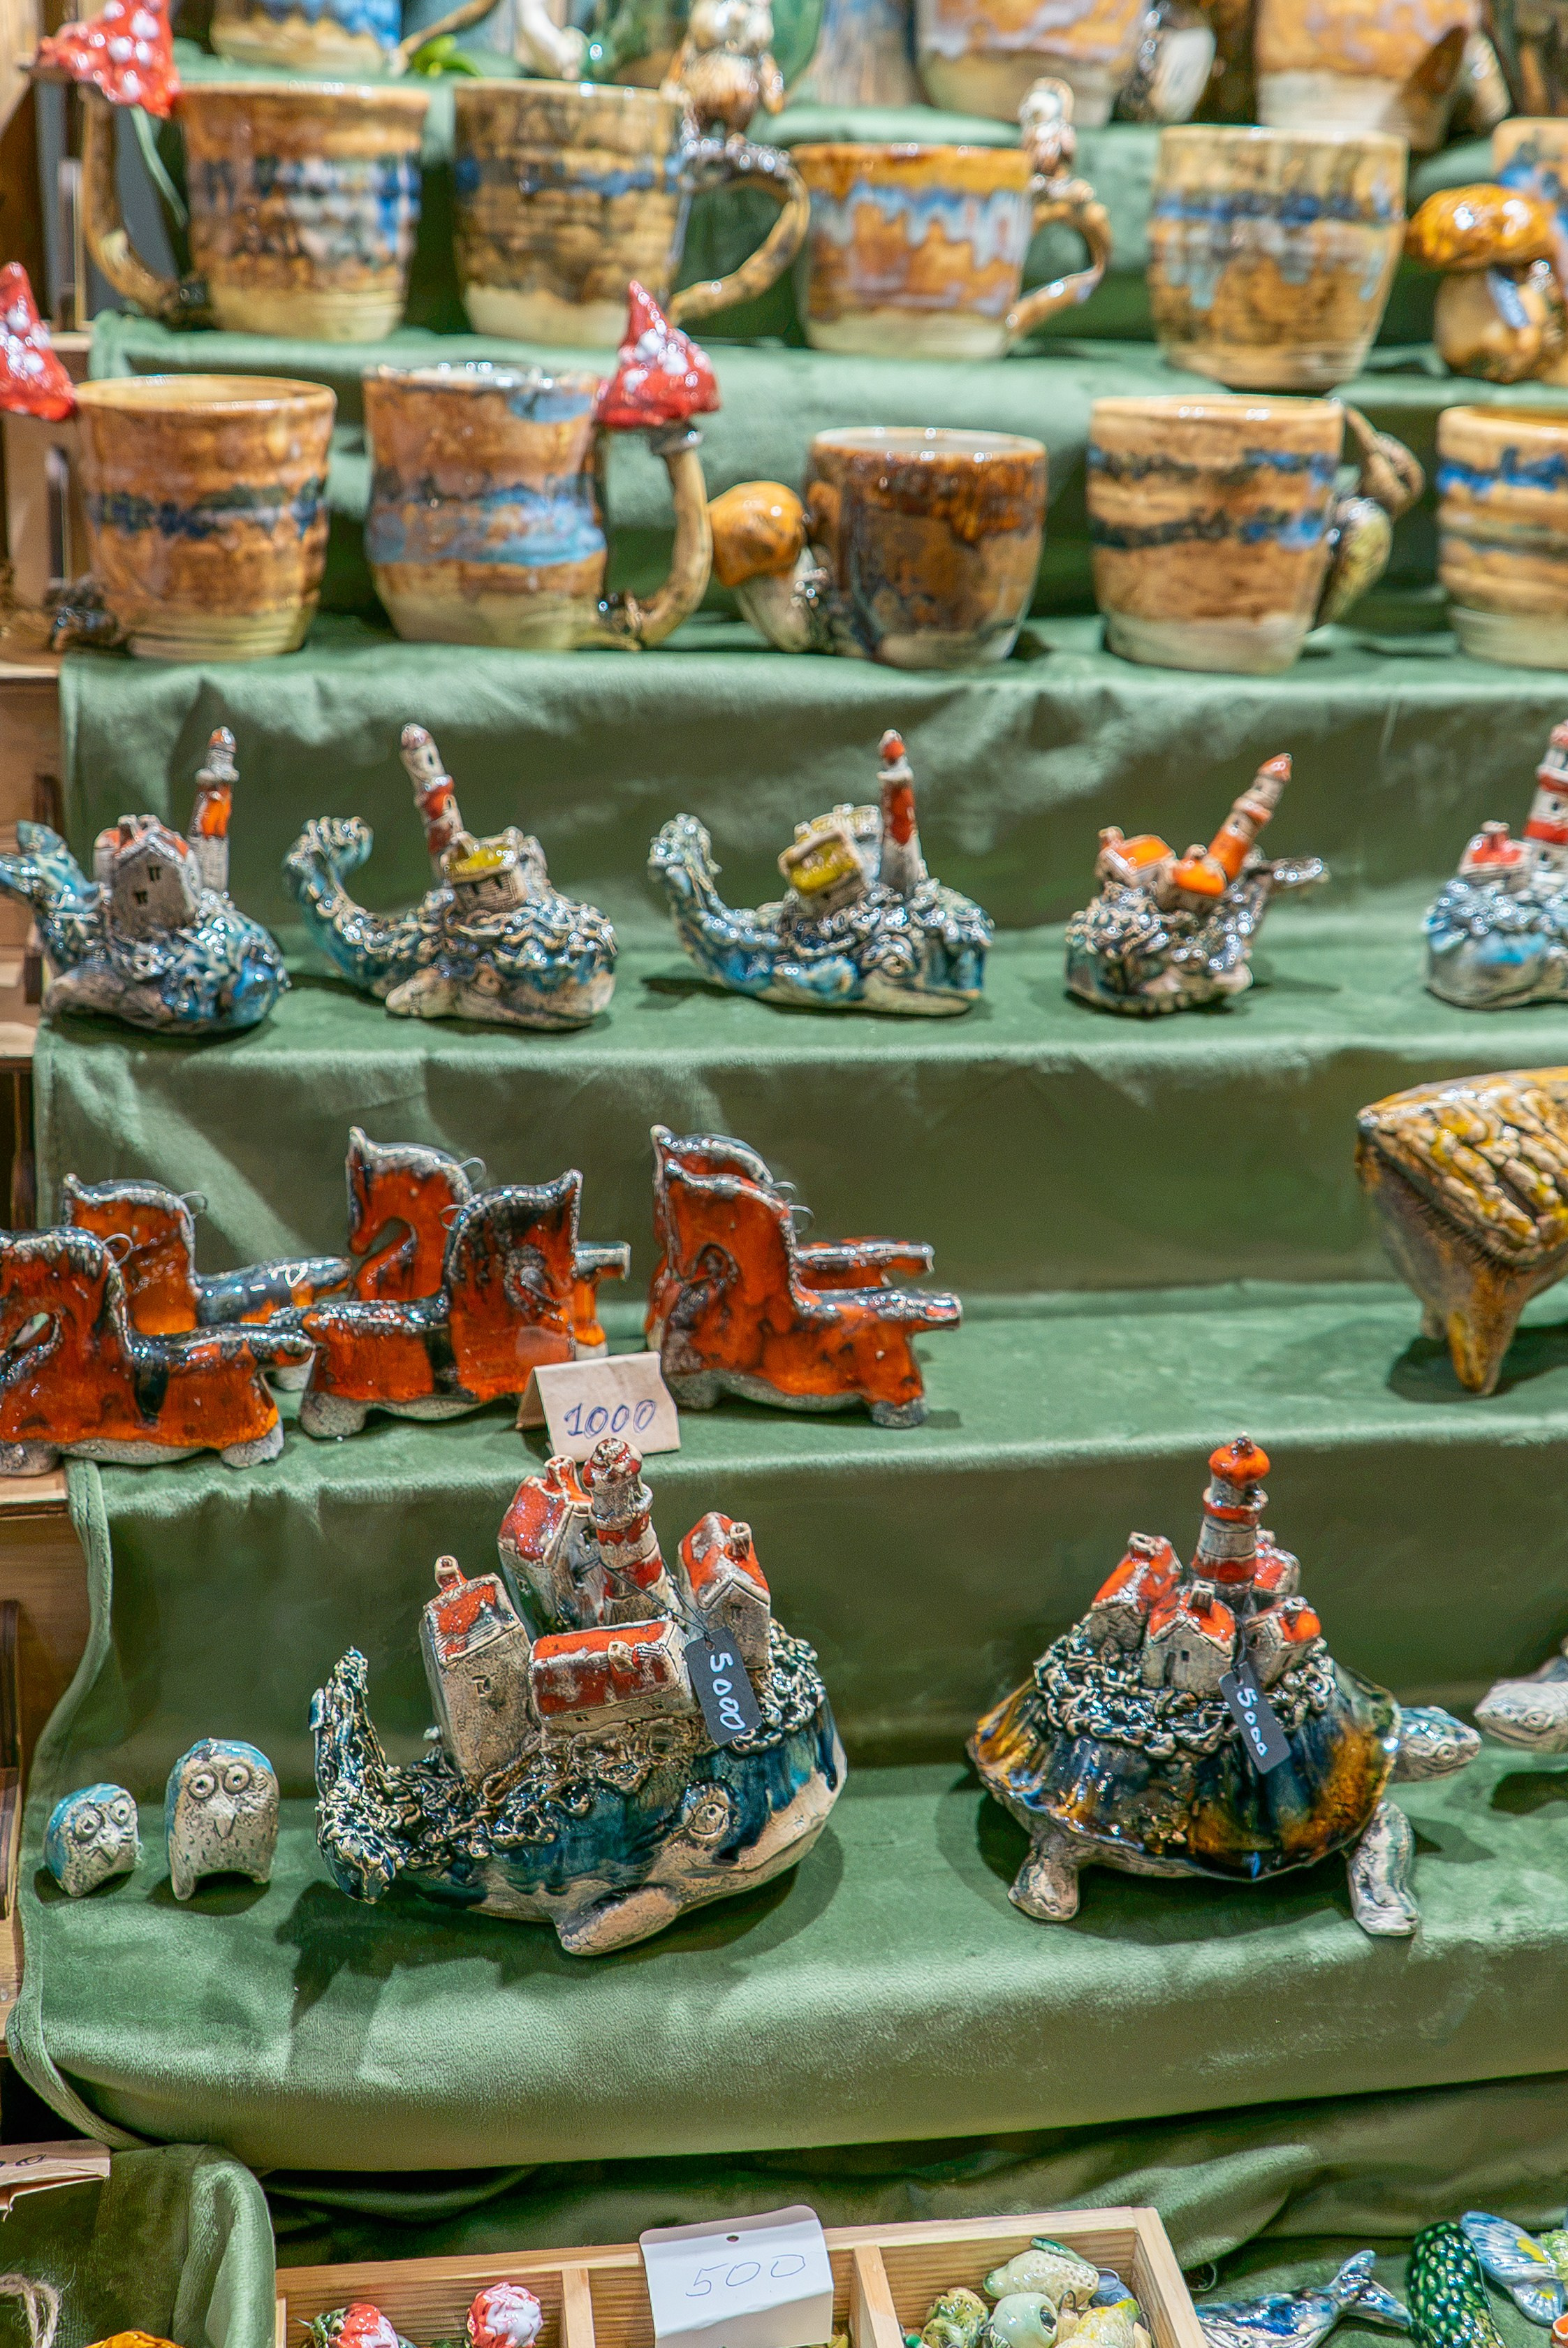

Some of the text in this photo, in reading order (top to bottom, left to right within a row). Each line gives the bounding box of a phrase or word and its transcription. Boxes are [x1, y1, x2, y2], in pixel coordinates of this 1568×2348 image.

[564, 1399, 657, 1439] 1000
[710, 1652, 747, 1730] 5000
[1236, 1688, 1269, 1758] 5000
[685, 2254, 806, 2297] 500
